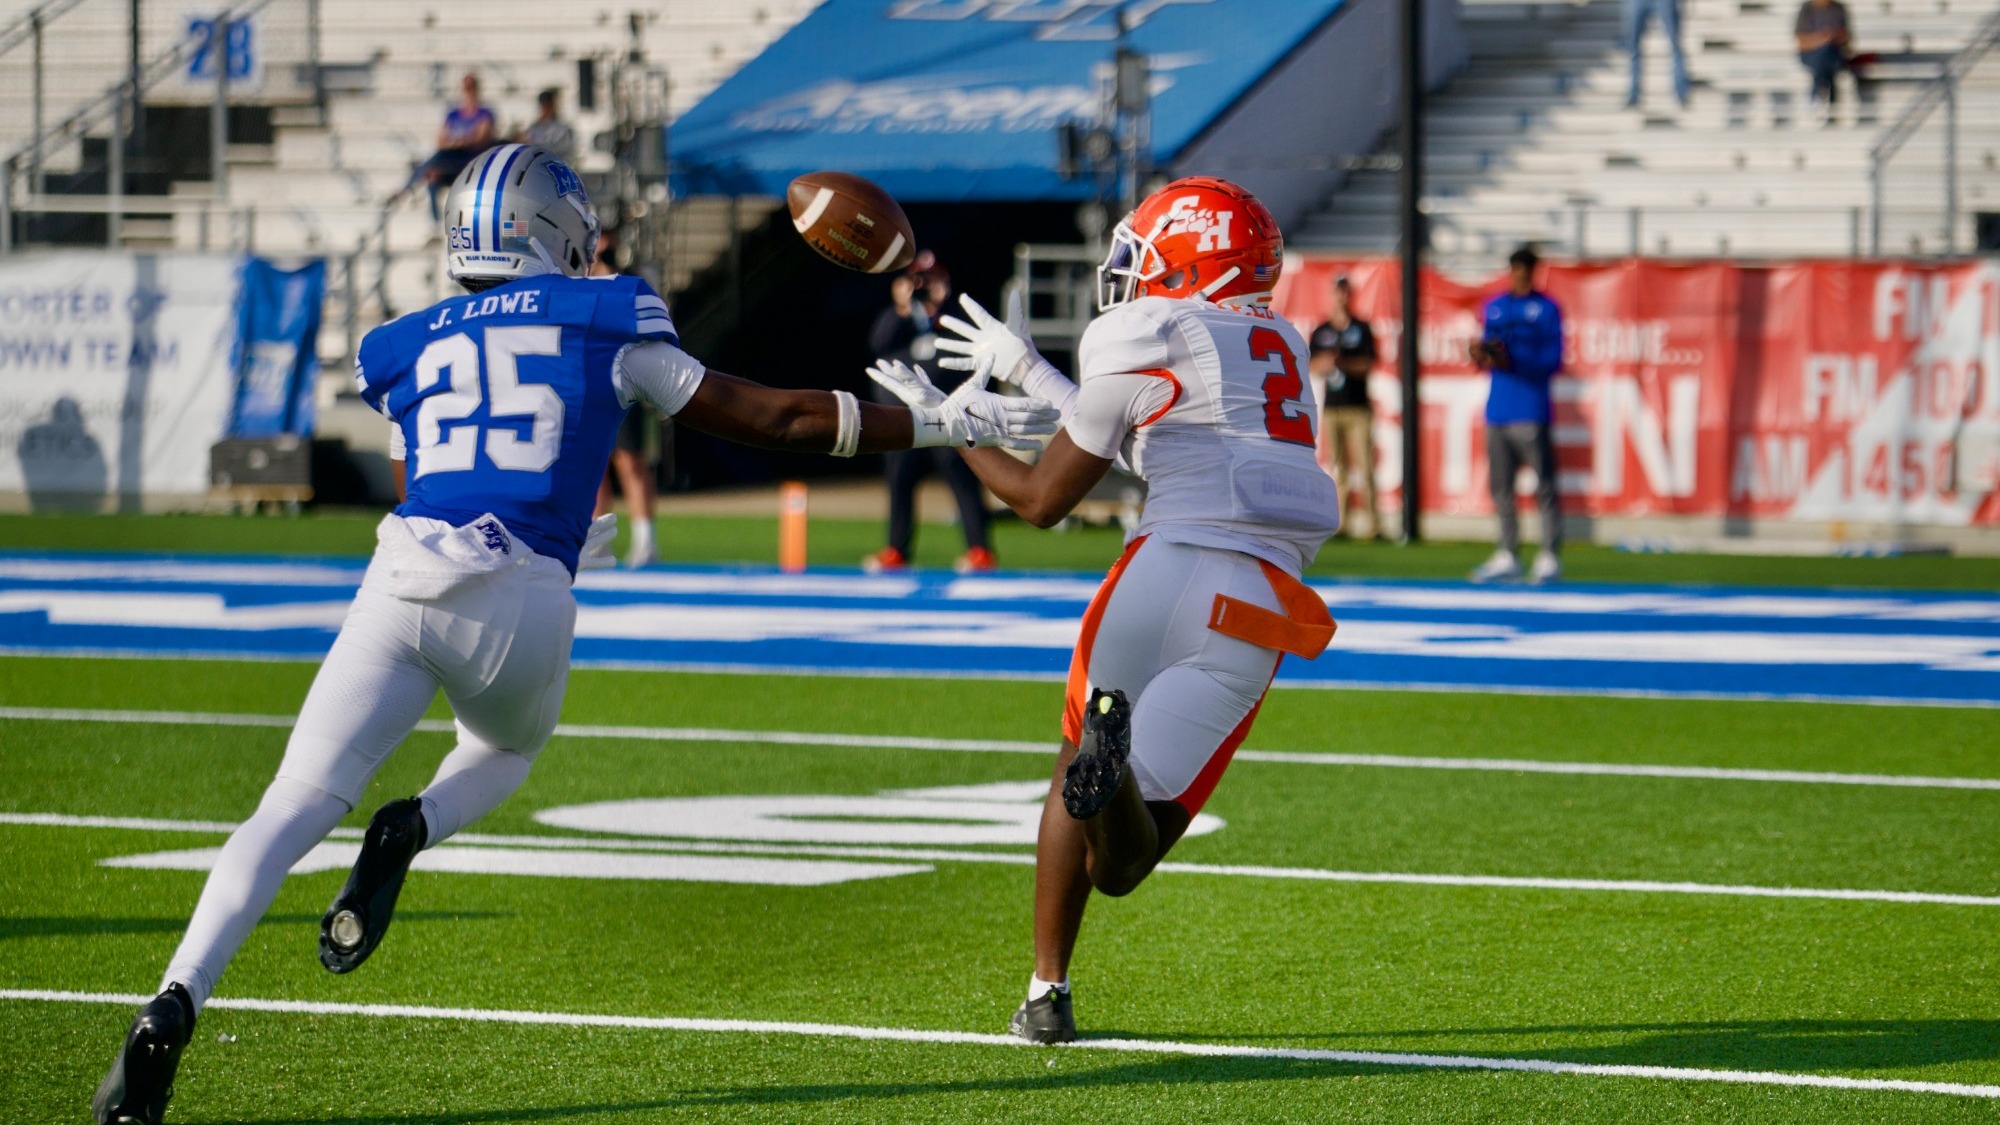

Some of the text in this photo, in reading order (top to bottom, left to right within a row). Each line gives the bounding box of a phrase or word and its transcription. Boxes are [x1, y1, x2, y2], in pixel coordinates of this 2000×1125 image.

[188, 18, 251, 80] 28
[450, 226, 473, 250] 25
[481, 255, 511, 263] RAIDERS
[827, 228, 869, 260] Wilson
[430, 290, 540, 331] J. LOWE
[413, 325, 566, 481] 25
[1248, 325, 1316, 450] 2
[1803, 354, 1878, 424] FM
[1729, 431, 1808, 500] AM
